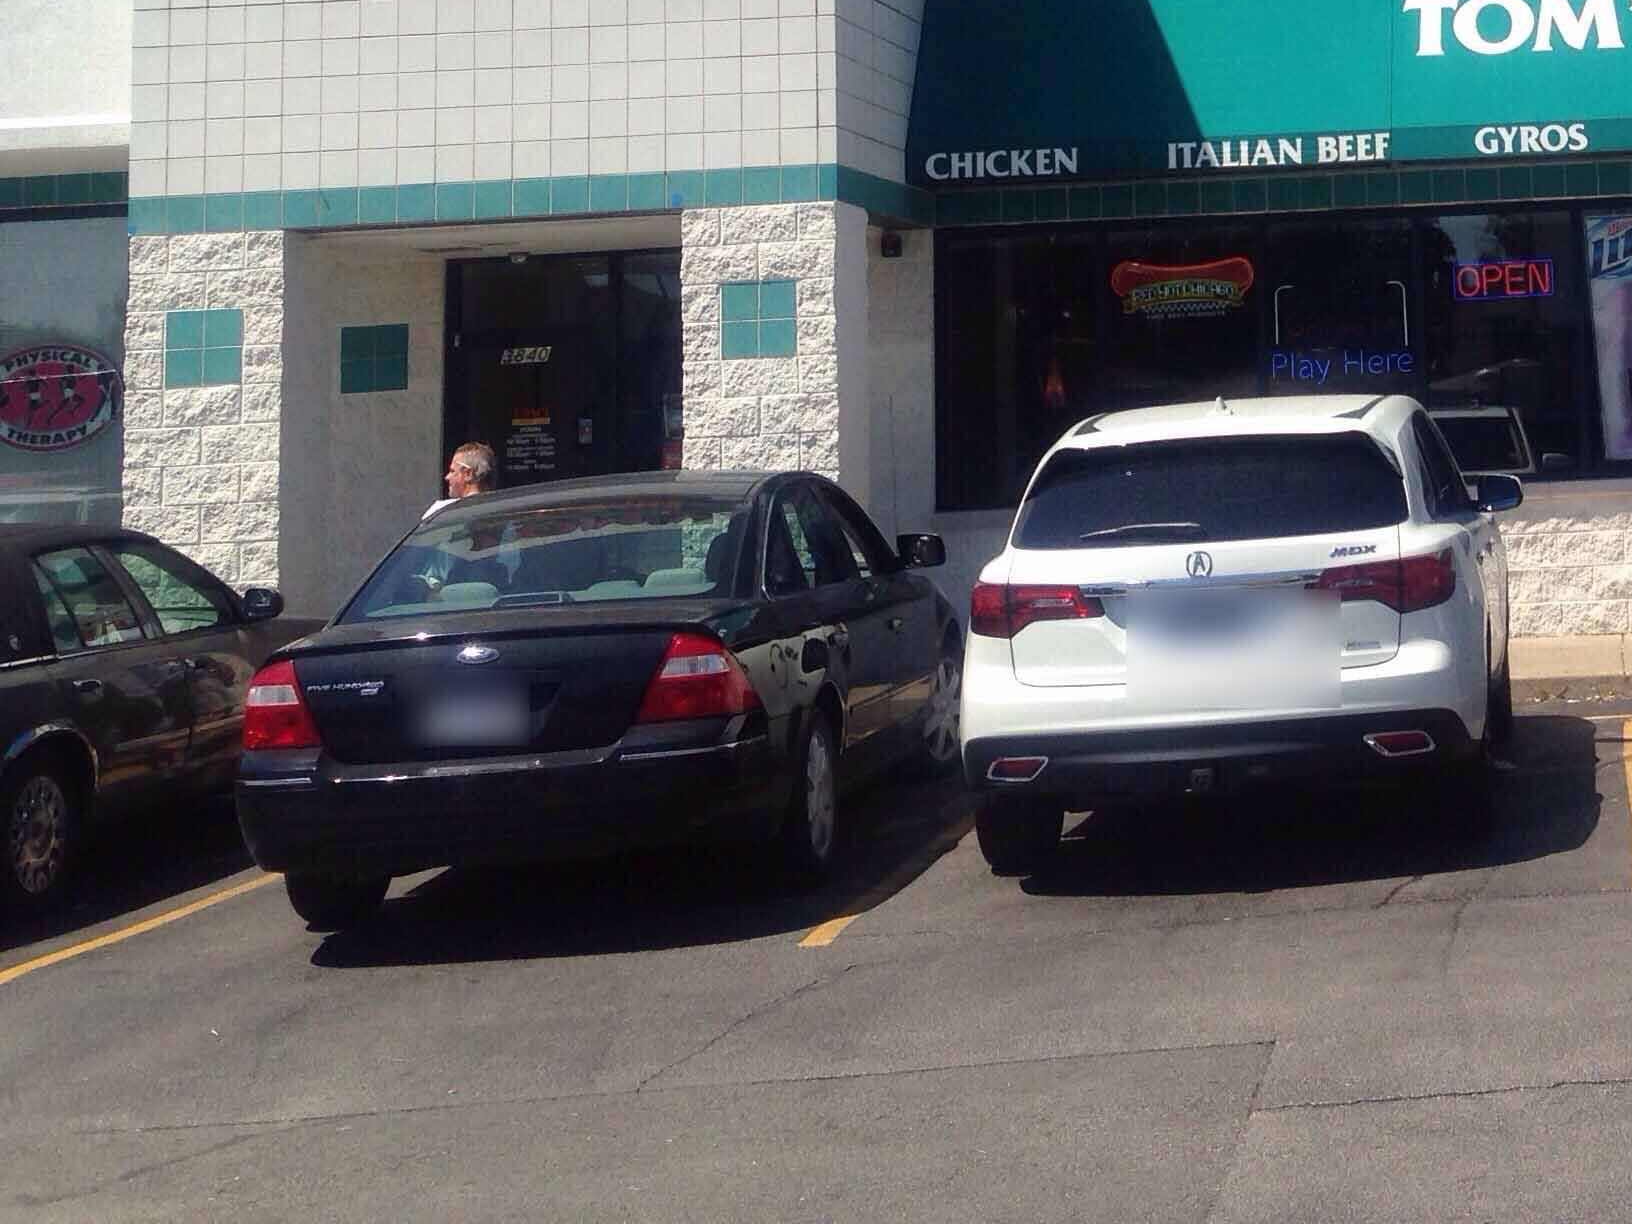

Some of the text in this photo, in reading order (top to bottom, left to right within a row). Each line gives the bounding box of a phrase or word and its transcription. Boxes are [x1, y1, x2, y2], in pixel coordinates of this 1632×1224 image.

[1167, 132, 1390, 169] ITALIAN BEEF
[1474, 123, 1588, 154] GYROS
[925, 147, 1079, 180] CHICKEN
[1457, 262, 1550, 297] OPEN
[5, 350, 92, 373] PHYSICAL
[1271, 349, 1415, 384] Play Here
[8, 425, 88, 445] THERAPY
[1328, 544, 1378, 558] MDX
